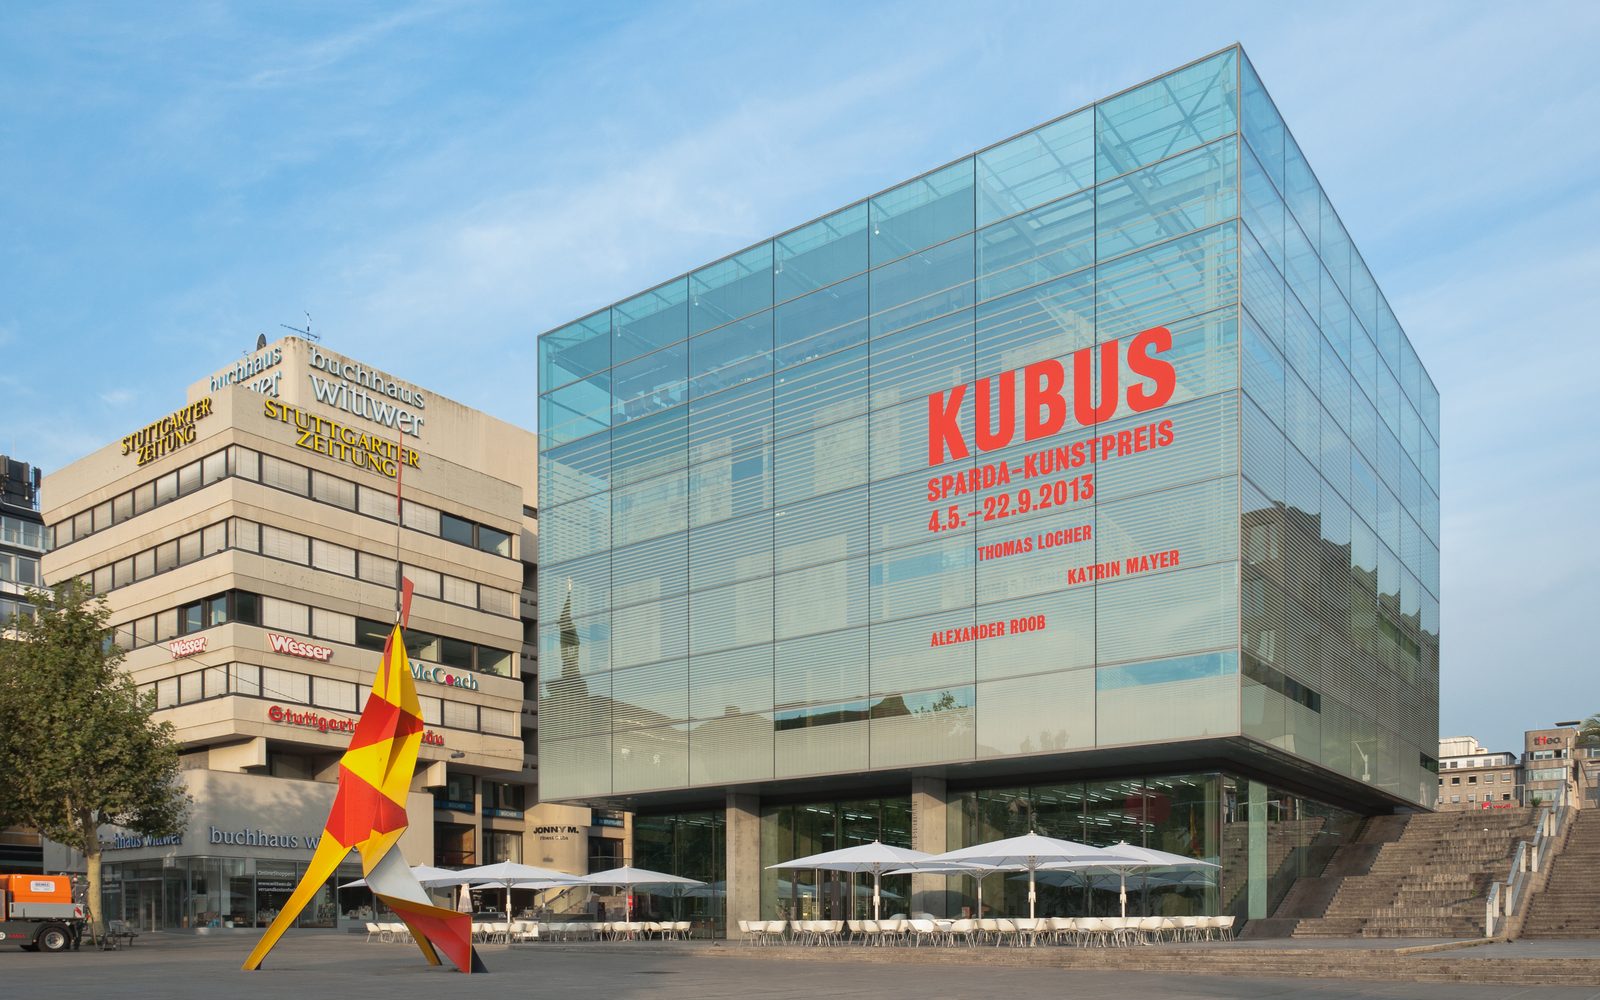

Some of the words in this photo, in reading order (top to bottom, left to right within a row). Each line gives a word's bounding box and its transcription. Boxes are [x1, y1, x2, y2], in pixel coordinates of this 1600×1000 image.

[209, 347, 282, 393] buchhaus
[309, 346, 424, 409] buchhaus
[308, 374, 424, 438] wittwer
[928, 326, 1176, 466] KUBUS
[121, 397, 213, 456] STUTTGARTER
[136, 424, 196, 467] ZEITUNG
[264, 399, 421, 469] STUTTGARTER
[296, 428, 397, 477] ZEITUNG
[928, 420, 1174, 501] SPARDA-KUNSTPREIS
[978, 537, 1033, 561] THOMAS
[1038, 525, 1091, 550] LOCHER
[1068, 561, 1120, 584] KATRIN
[1127, 550, 1179, 574] MAYER
[170, 638, 207, 659] Wesser
[268, 634, 333, 661] Wesser
[931, 622, 1005, 647] ALEXANDER
[1010, 615, 1046, 634] ROOB
[210, 826, 298, 848] buchhaus
[533, 826, 566, 834] JONNY
[567, 826, 579, 834] M.
